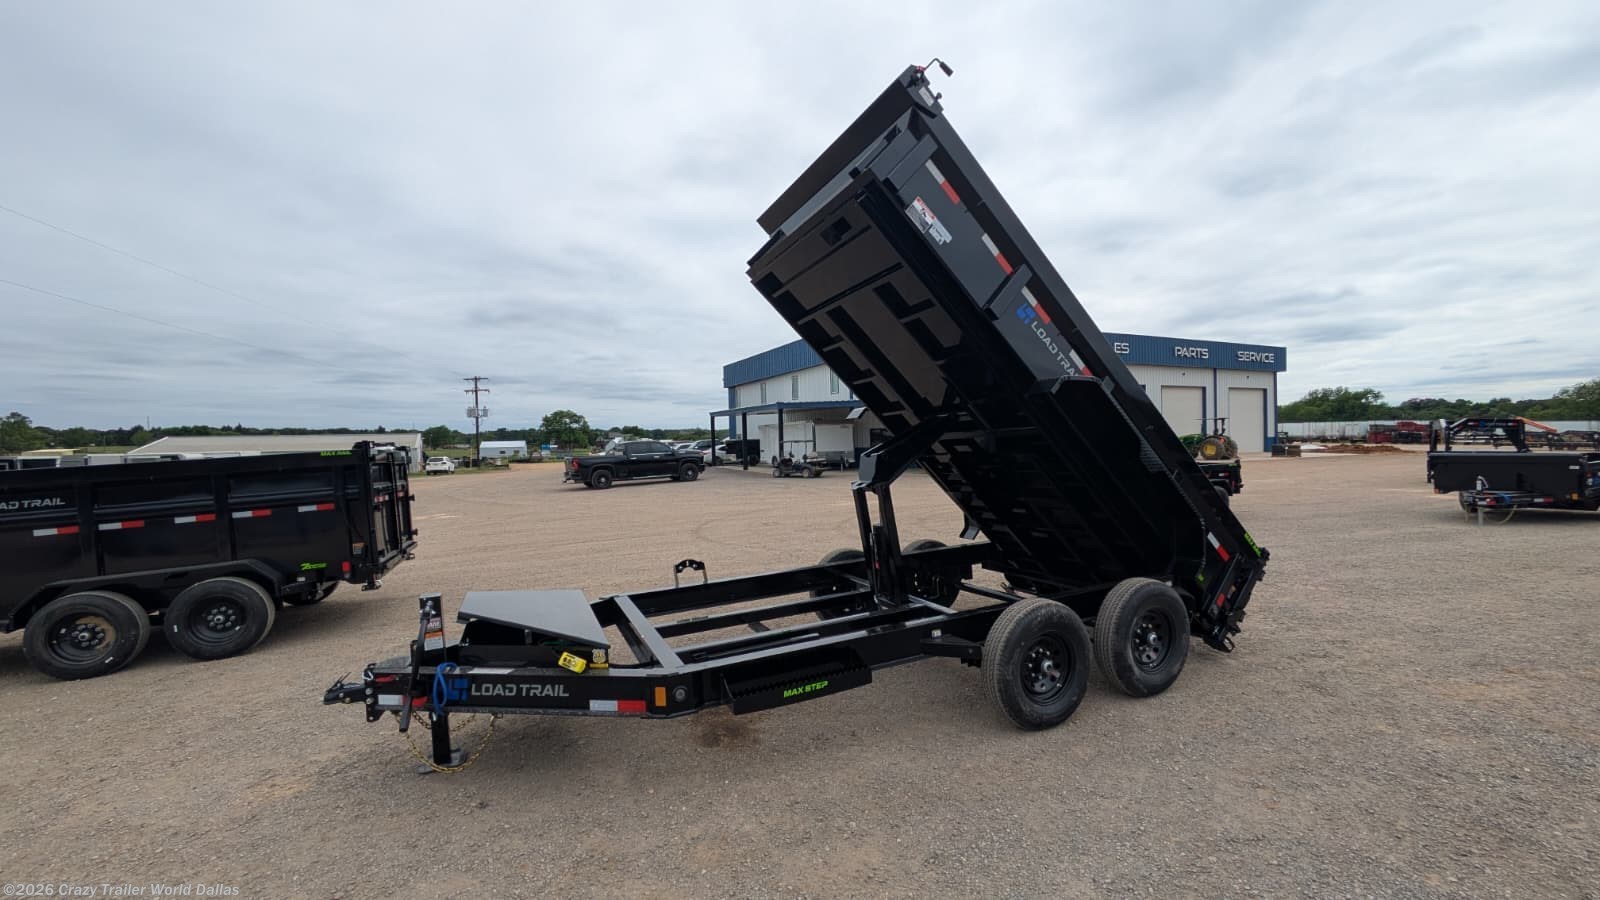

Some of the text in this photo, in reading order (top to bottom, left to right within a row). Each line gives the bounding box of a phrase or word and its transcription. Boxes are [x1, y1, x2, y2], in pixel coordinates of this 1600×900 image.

[1031, 321, 1079, 376] LOAD TRA
[1175, 346, 1209, 359] PARTS
[1237, 351, 1275, 363] SERVICE
[21, 498, 66, 508] TRAIL
[471, 683, 569, 697] LOAD TRAIL
[783, 680, 829, 698] MAX STEP
